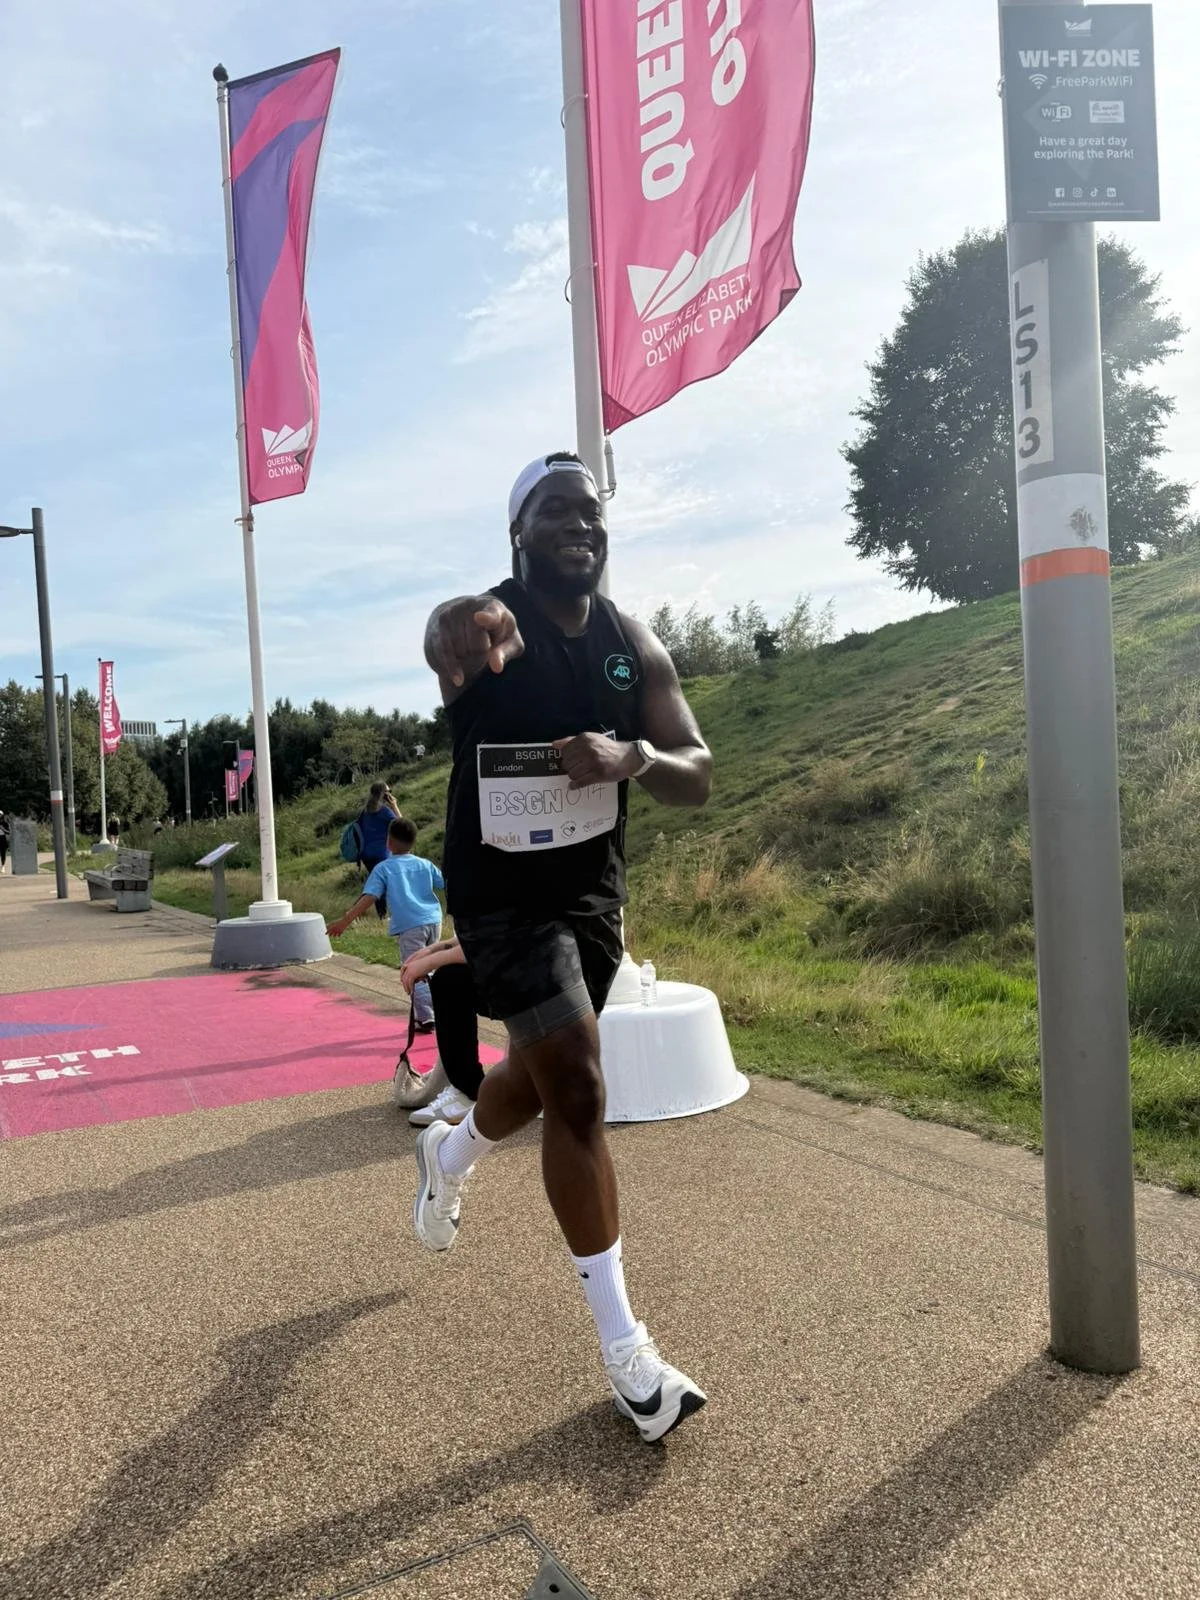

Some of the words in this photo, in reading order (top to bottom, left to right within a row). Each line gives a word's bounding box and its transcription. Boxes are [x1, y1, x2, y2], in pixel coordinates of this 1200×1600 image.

[706, 0, 748, 106] OL
[1018, 49, 1078, 68] WI-FI
[1082, 48, 1141, 68] ZONE
[636, 0, 695, 201] QUEE
[1034, 148, 1085, 161] exploring
[1086, 149, 1104, 159] the
[1106, 149, 1134, 159] Park!
[1039, 136, 1067, 146] Have
[1068, 138, 1076, 146] a
[1078, 136, 1105, 148] great
[1108, 136, 1128, 148] day
[646, 314, 705, 368] OLYMPIC
[708, 287, 753, 328] PARK
[1013, 281, 1042, 459] LS13
[266, 455, 292, 468] QUEEN
[103, 665, 116, 733] WELCOME
[493, 763, 524, 772] London
[515, 750, 545, 760] BSGN
[489, 788, 563, 817] BSGN
[1, 1045, 141, 1070] ETH
